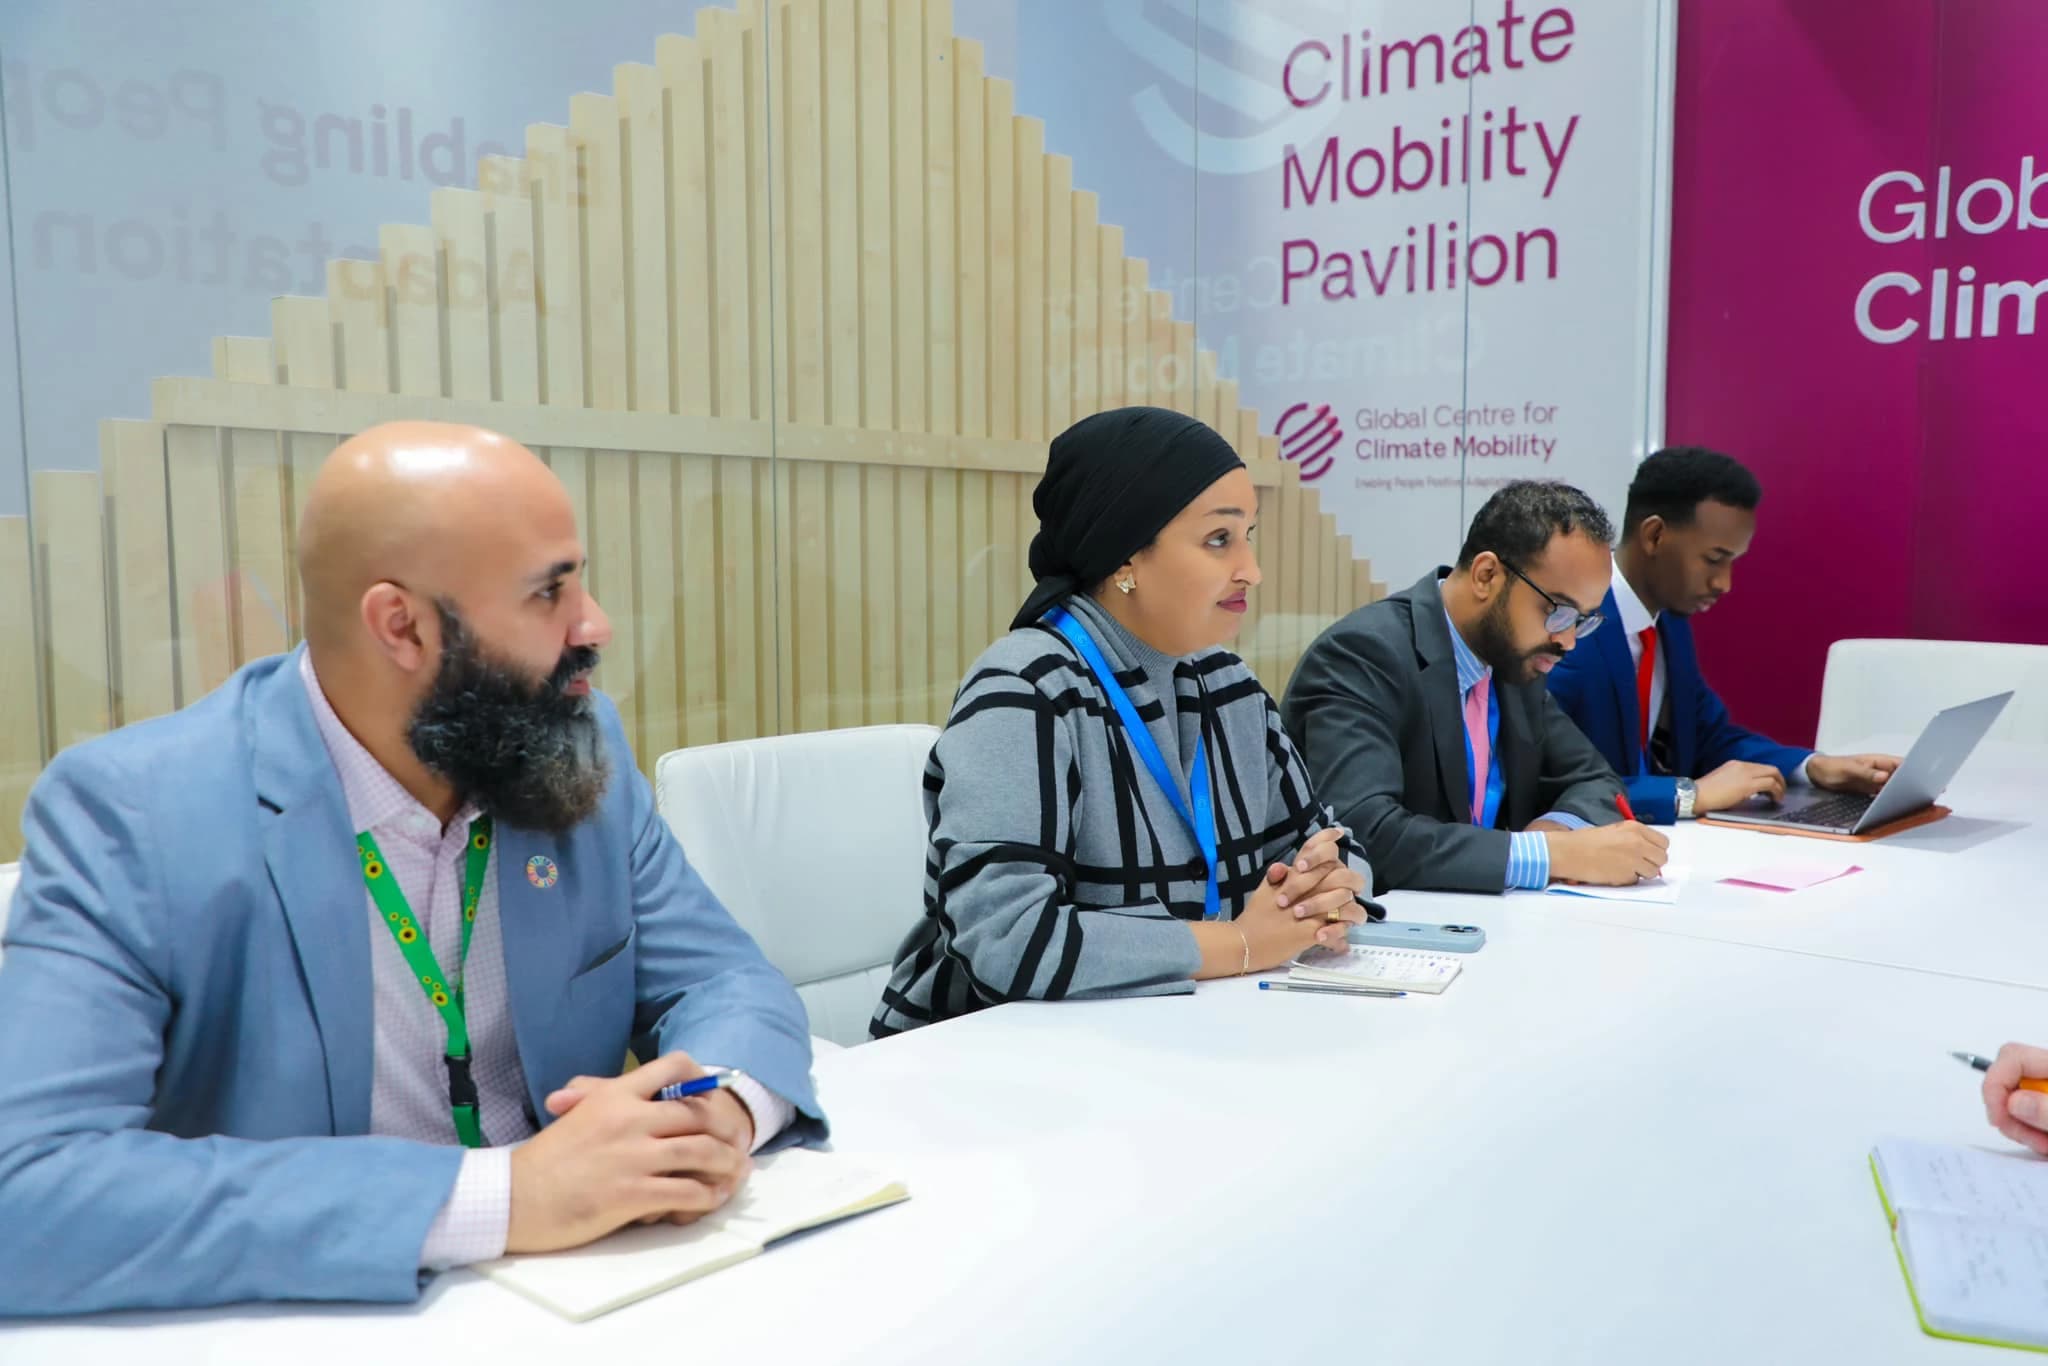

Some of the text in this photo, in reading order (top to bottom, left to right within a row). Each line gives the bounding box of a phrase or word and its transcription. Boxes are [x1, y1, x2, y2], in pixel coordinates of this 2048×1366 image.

[1282, 0, 1576, 109] Climate
[1282, 106, 1580, 210] Mobility
[1858, 156, 2048, 244] Glob
[1281, 220, 1559, 306] Pavilion
[1854, 265, 2048, 344] Clim
[1355, 401, 1559, 431] Global Centre for
[1355, 433, 1557, 463] Climate Mobility
